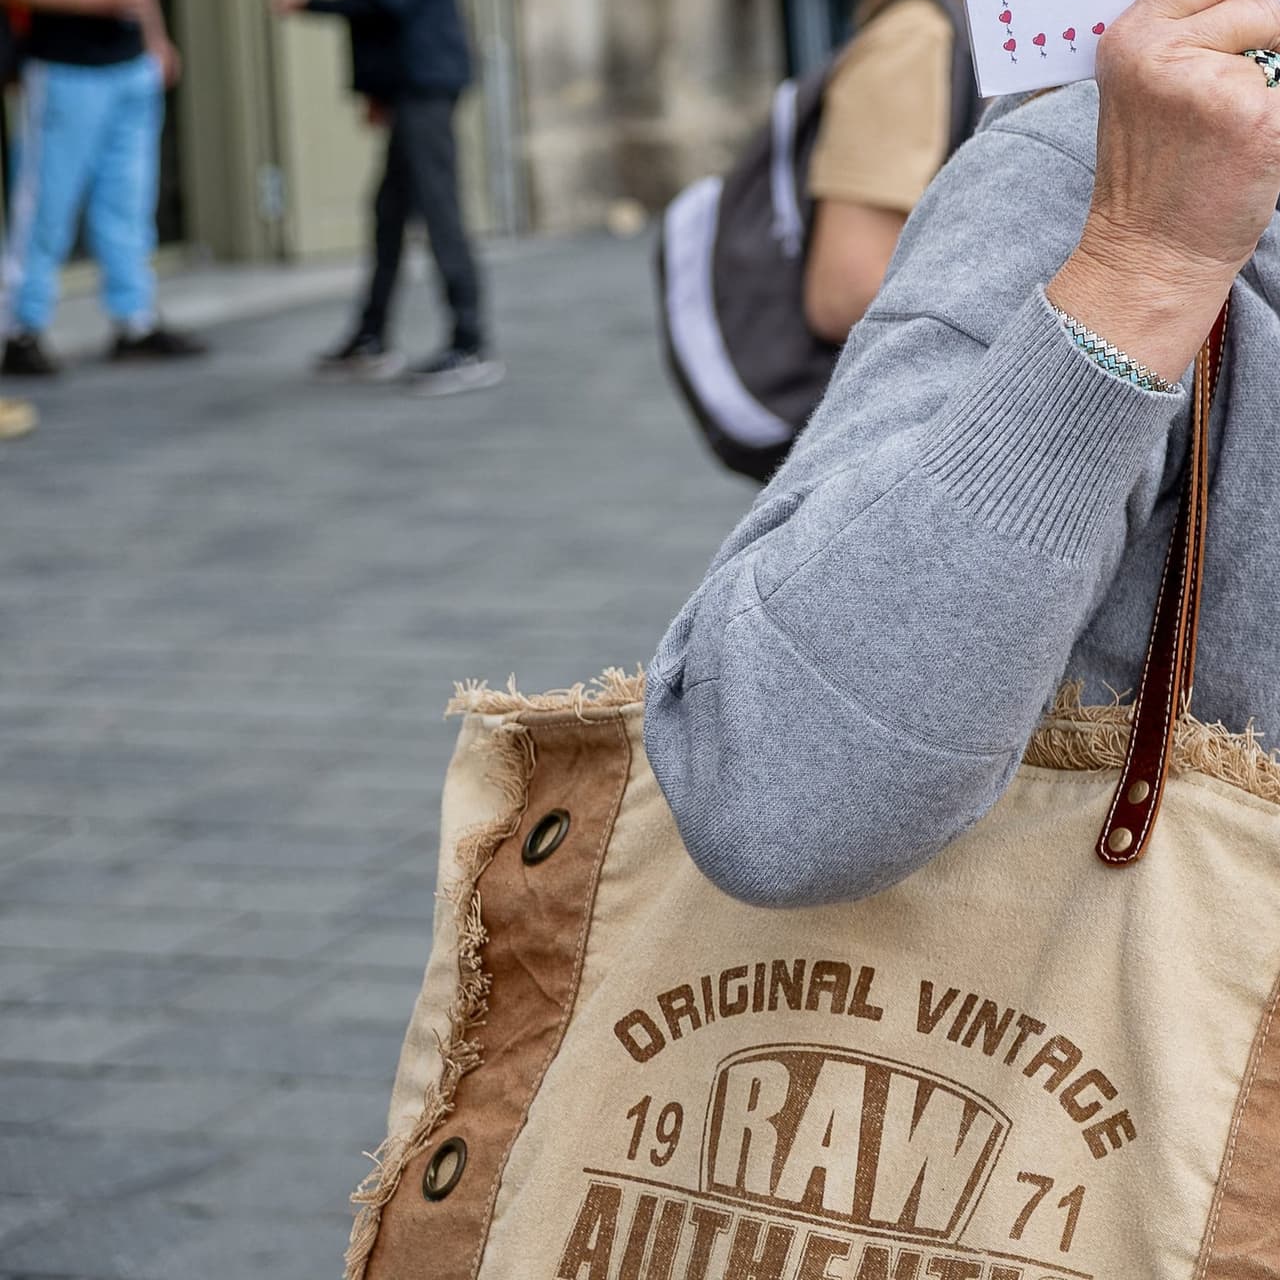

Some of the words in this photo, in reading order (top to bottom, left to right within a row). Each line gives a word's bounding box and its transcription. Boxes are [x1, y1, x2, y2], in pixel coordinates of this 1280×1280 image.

[613, 958, 884, 1064] ORIGINAL
[916, 979, 1137, 1159] VINTAGE
[625, 1094, 684, 1167] 19
[711, 1058, 993, 1225] RAW
[1008, 1170, 1086, 1252] 71
